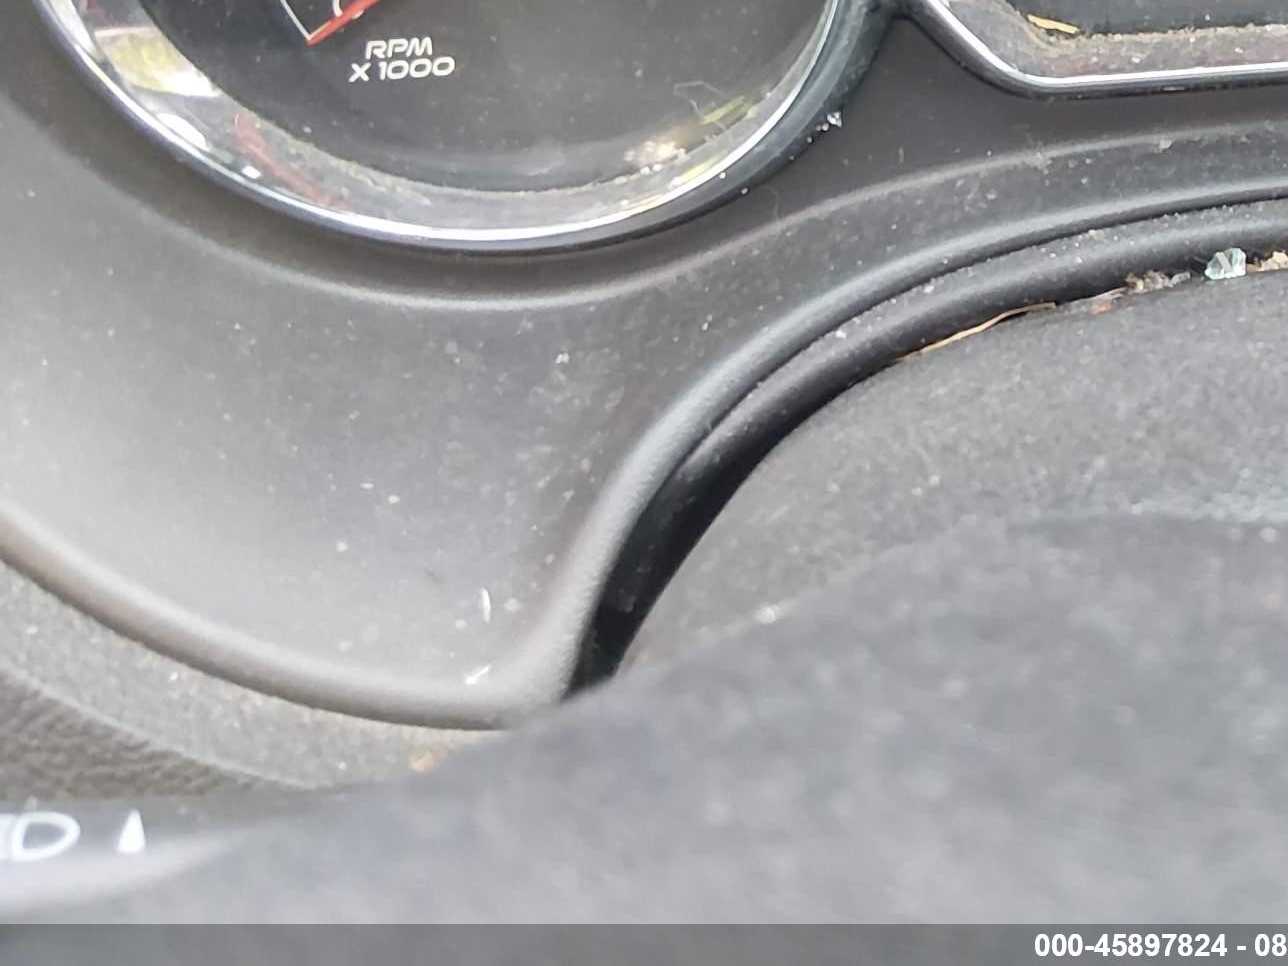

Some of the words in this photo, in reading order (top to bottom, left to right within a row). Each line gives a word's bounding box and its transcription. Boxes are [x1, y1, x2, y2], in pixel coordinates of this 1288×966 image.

[365, 36, 433, 60] RPM
[348, 62, 371, 83] X
[377, 55, 457, 81] 1000
